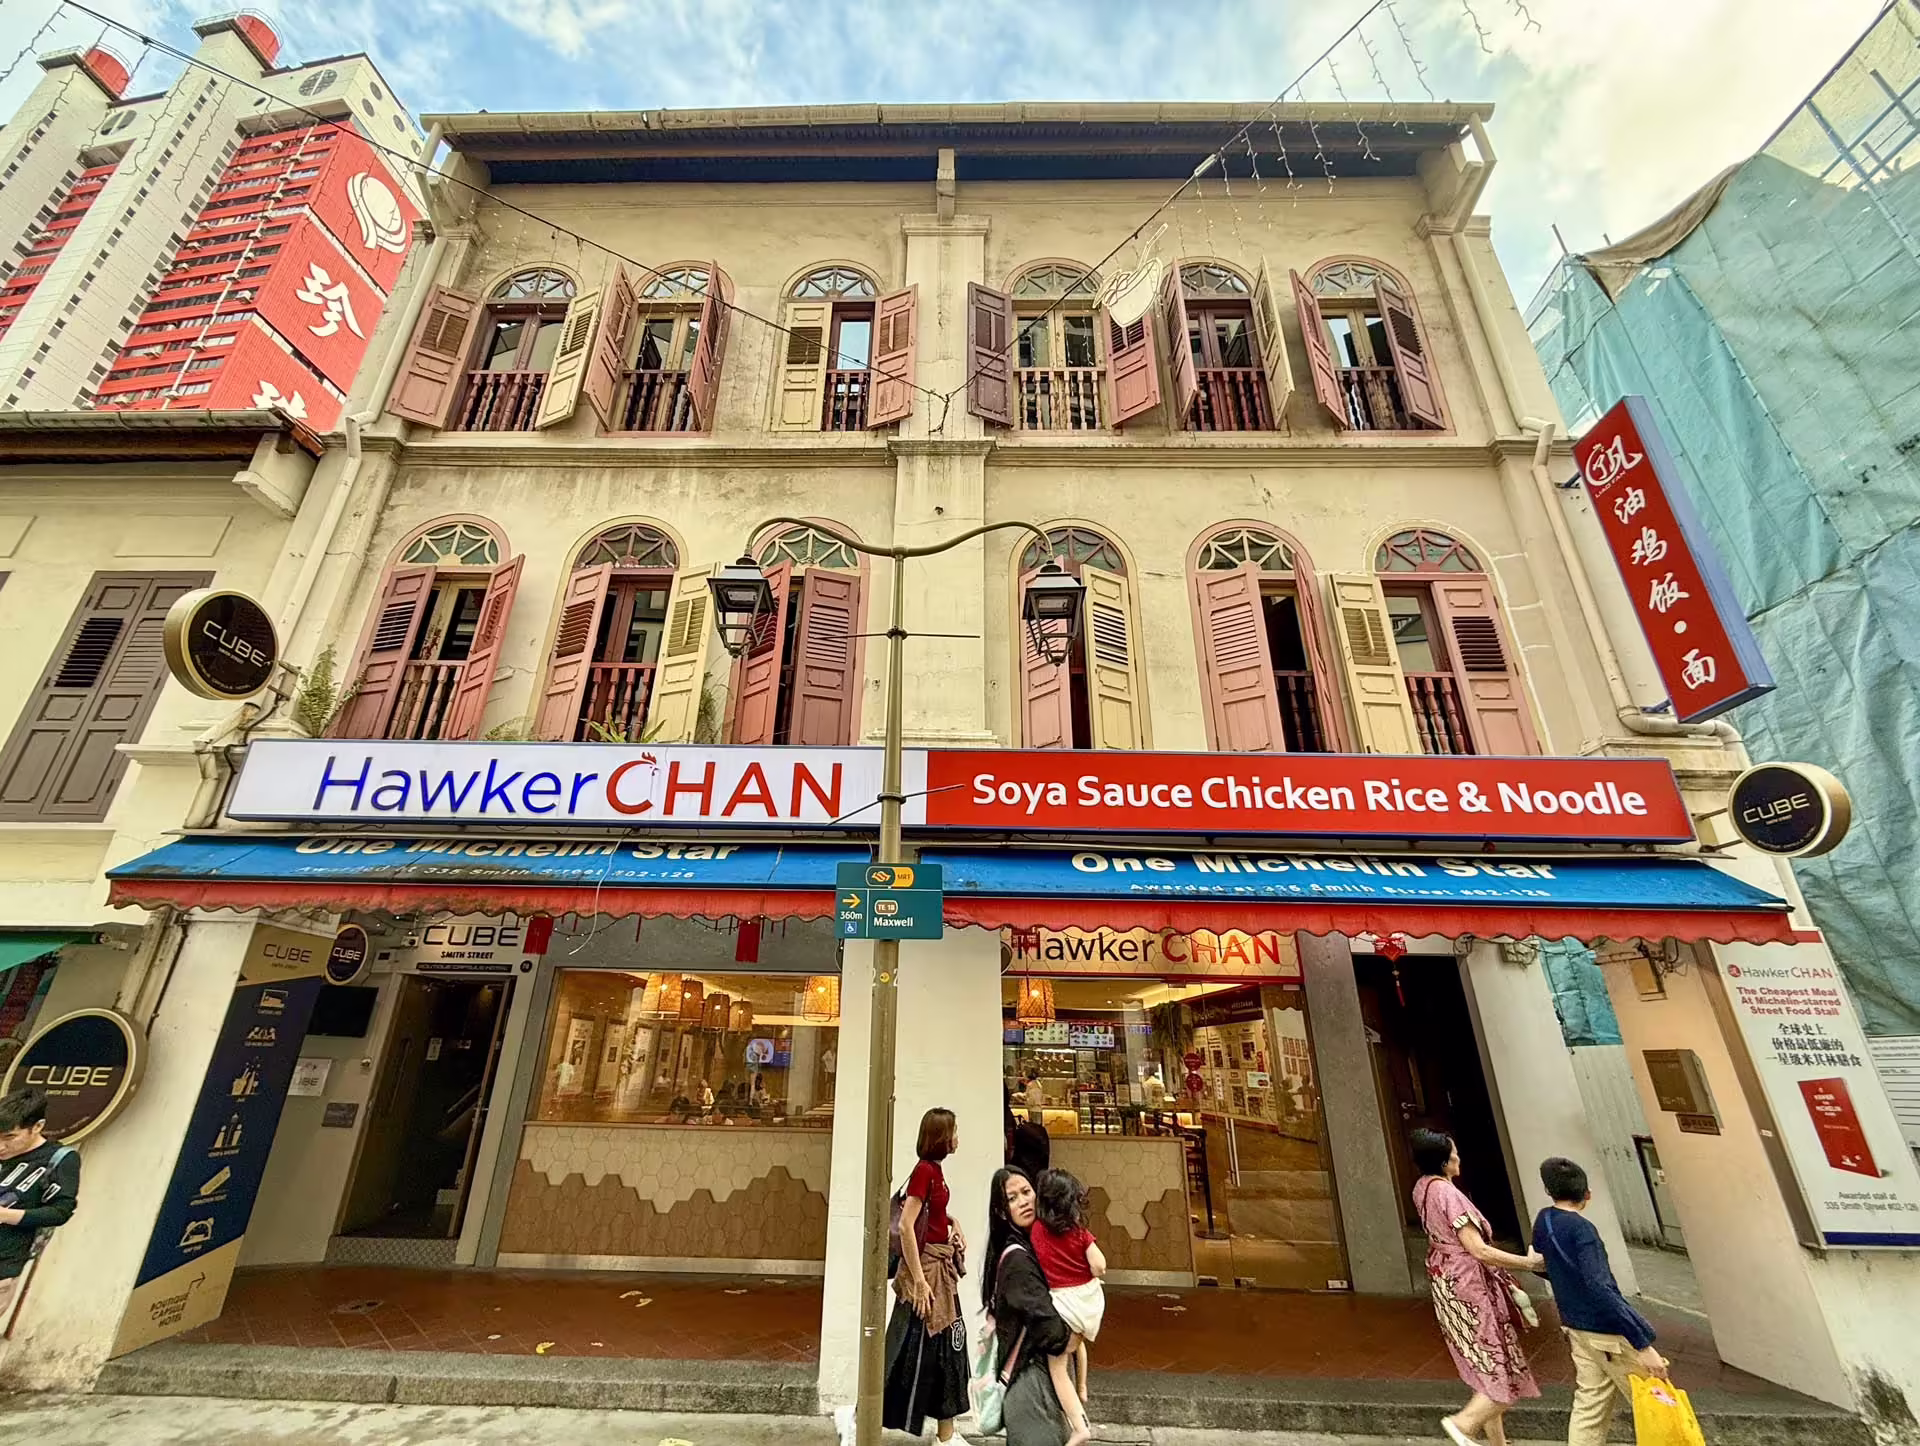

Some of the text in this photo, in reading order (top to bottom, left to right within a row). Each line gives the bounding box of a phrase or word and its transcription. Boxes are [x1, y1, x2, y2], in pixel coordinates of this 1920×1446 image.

[203, 620, 267, 668] CUBE
[972, 774, 1648, 815] Soya Sauce Chicken Rice & Noodle
[1743, 793, 1811, 823] CUBE
[295, 838, 741, 860] One Michelin Star
[1071, 852, 1557, 880] One Michelin Star
[1130, 883, 1225, 892] Awarded
[1309, 883, 1376, 893] Smith
[1383, 886, 1454, 896] Street
[840, 911, 863, 920] 360m
[873, 917, 914, 927] Maxwell
[423, 925, 521, 946] CUBE
[262, 943, 313, 963] CUBE
[332, 947, 362, 960] CUBE
[441, 951, 495, 960] SMITH STREET
[1736, 986, 1838, 997] The Cheapest Meal
[1741, 997, 1842, 1007] At Michelin-starred
[1750, 1006, 1840, 1016] Street Food Stall
[1778, 1023, 1828, 1036] 全球史上
[1772, 1037, 1845, 1051] 价格最低廉的
[1765, 1053, 1863, 1068] 一星级米其林膳食
[26, 1065, 113, 1086] CUBE
[1838, 1191, 1872, 1200] Awarded
[1872, 1192, 1888, 1200] stall
[1823, 1201, 1840, 1210] 335
[1840, 1202, 1863, 1211] Smith
[1863, 1202, 1887, 1212] Street
